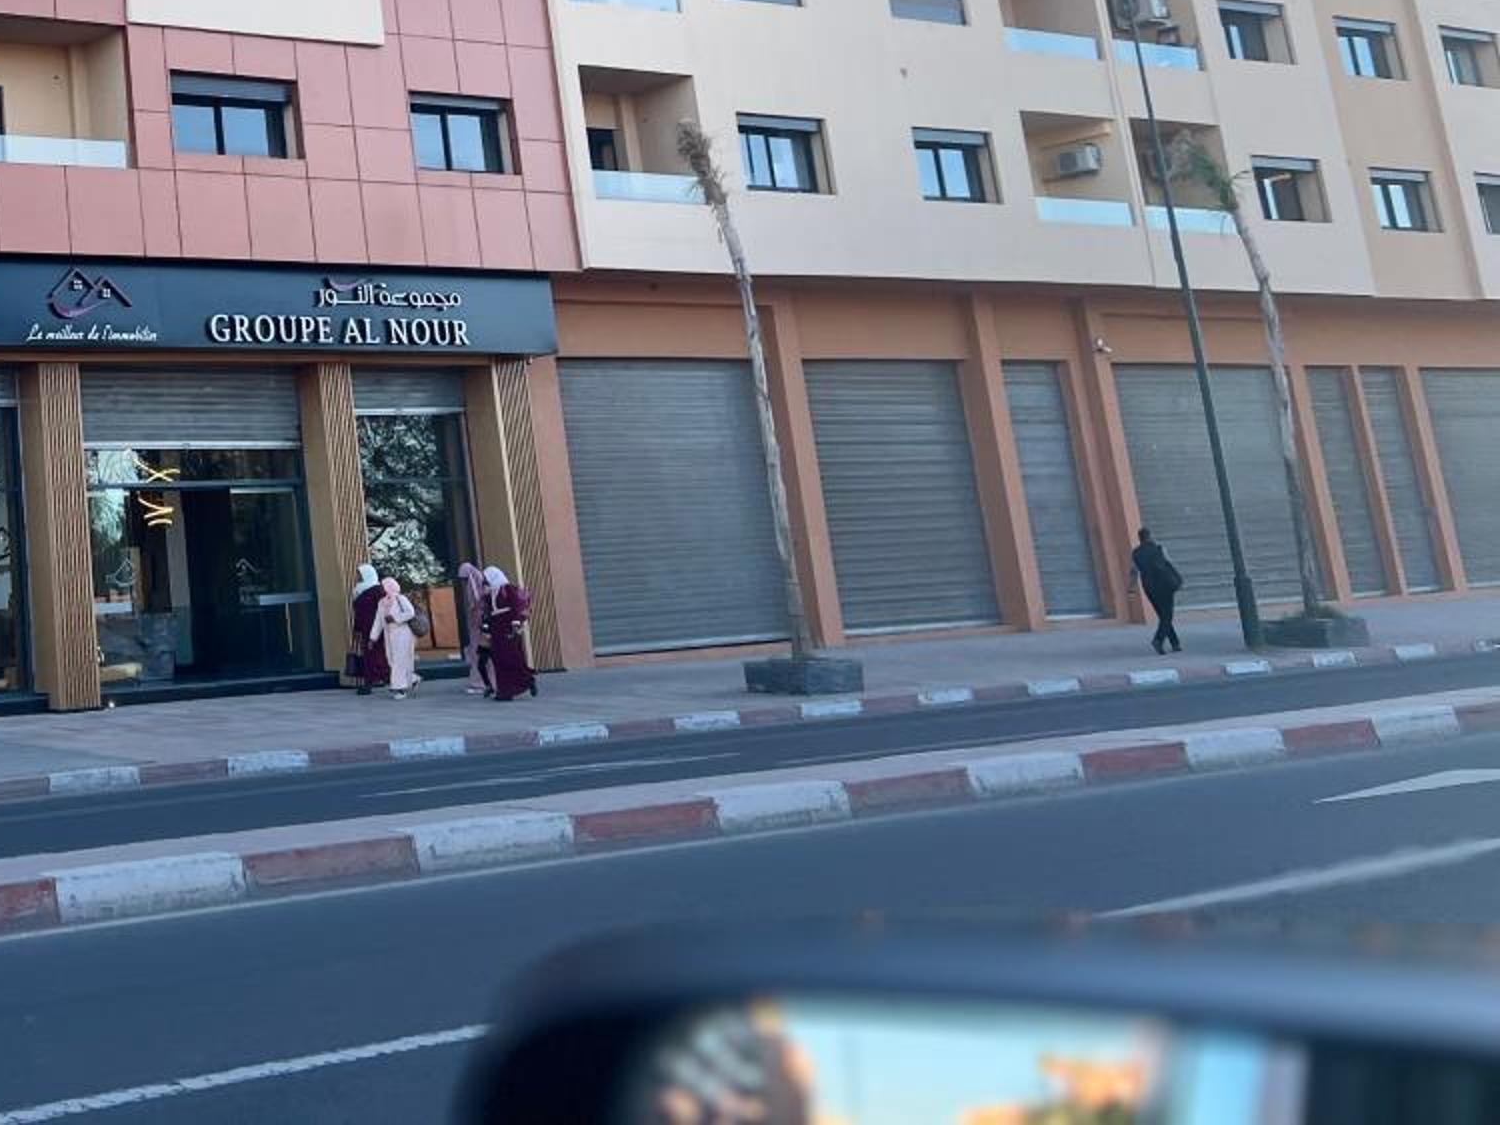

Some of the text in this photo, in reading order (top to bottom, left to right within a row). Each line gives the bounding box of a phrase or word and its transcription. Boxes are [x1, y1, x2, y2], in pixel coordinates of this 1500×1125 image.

[379, 282, 462, 311] مجموعة
[26, 323, 43, 342] Le
[87, 324, 100, 340] de
[210, 313, 471, 346] GROUPE AL NOUR
